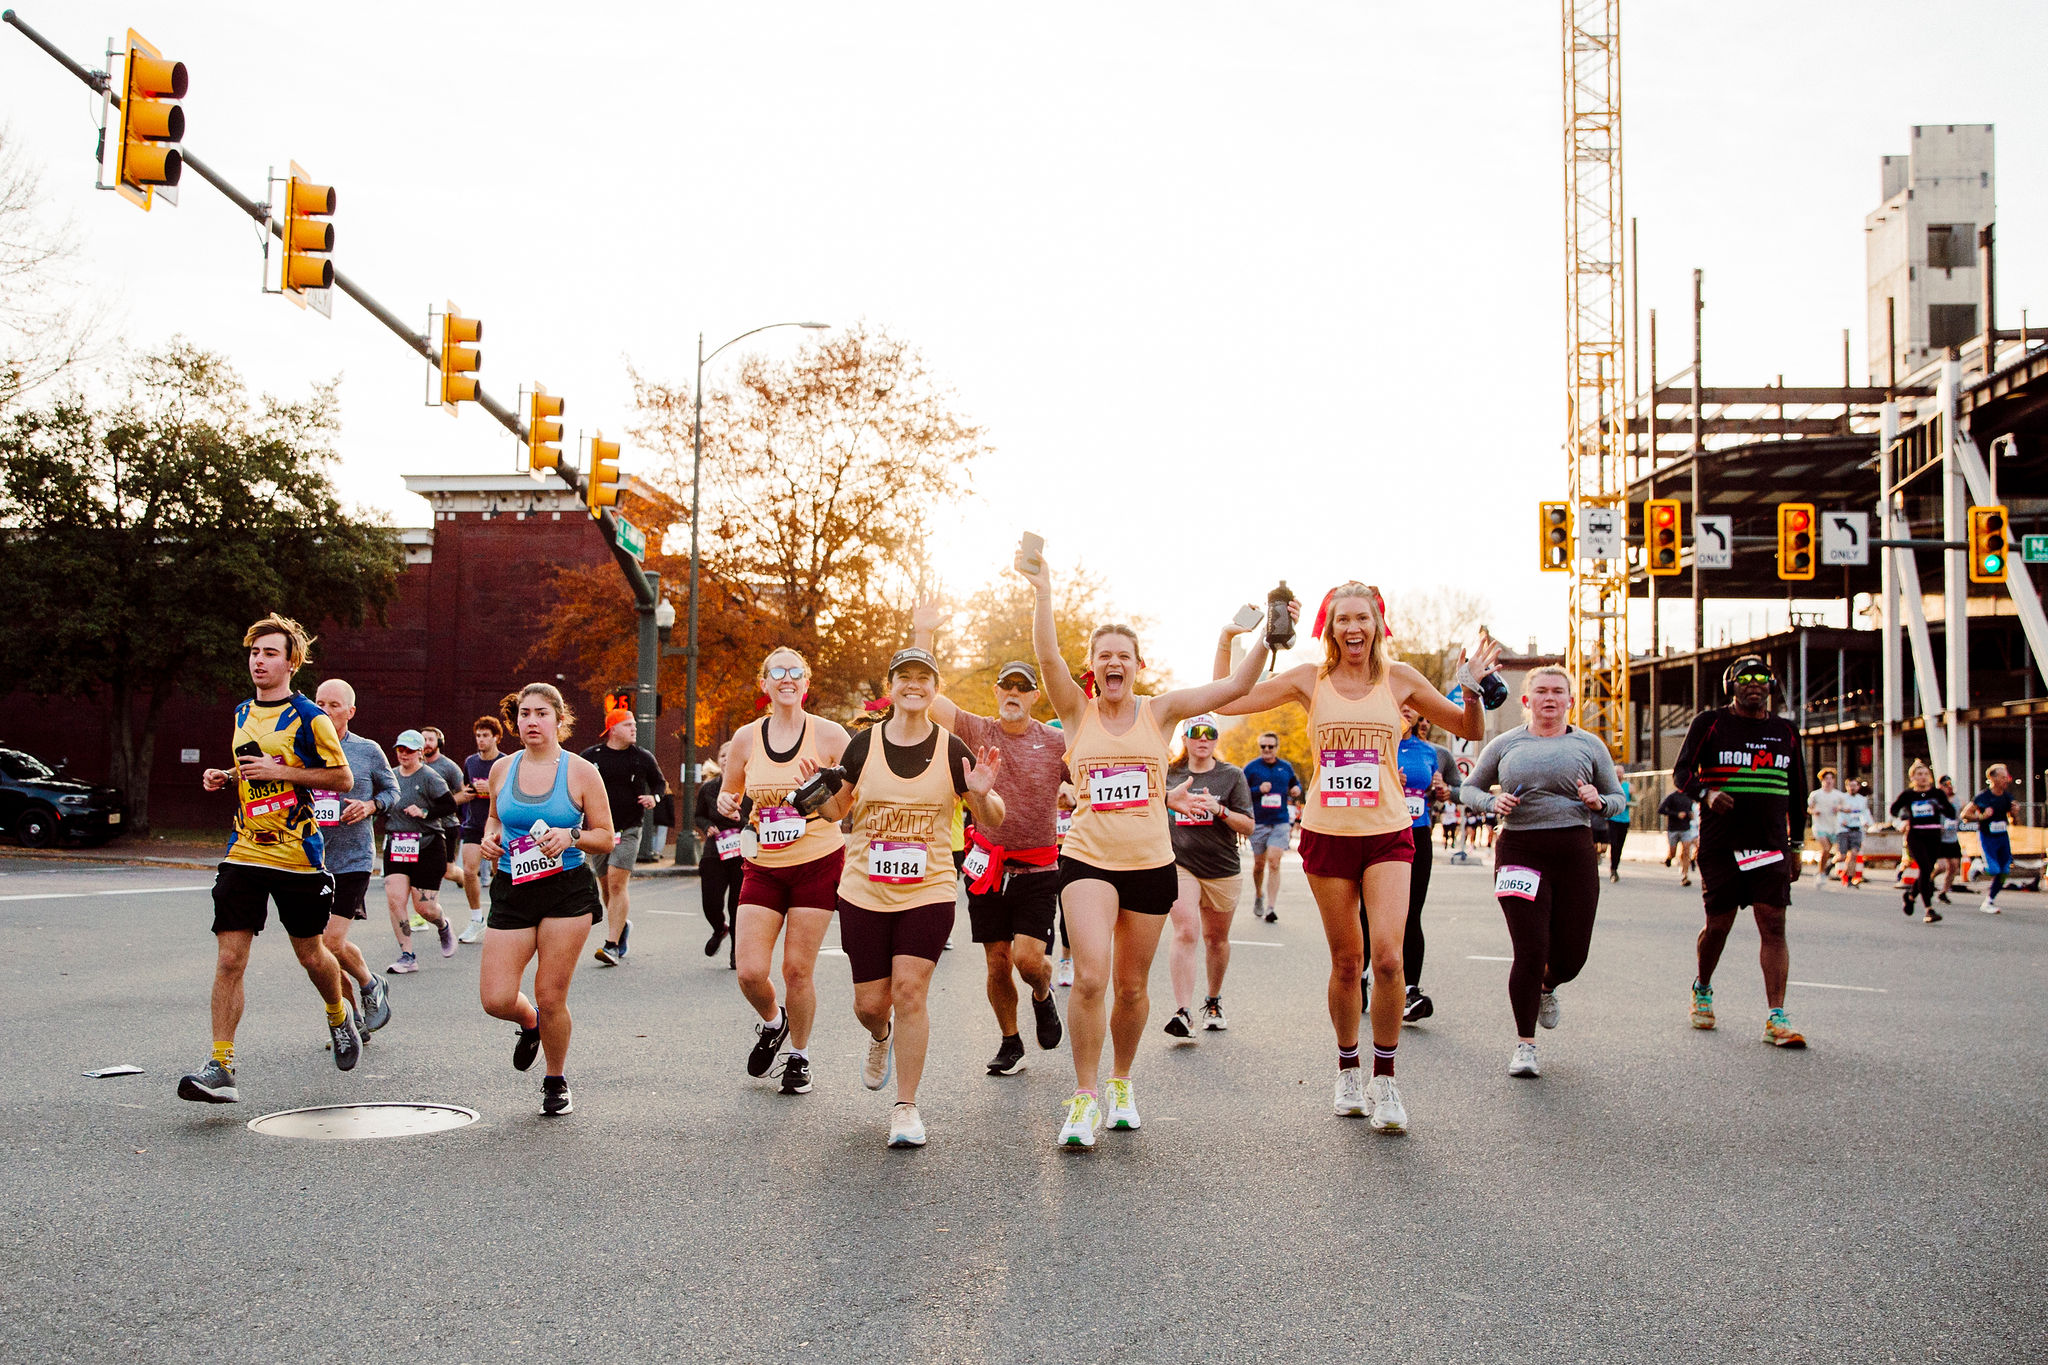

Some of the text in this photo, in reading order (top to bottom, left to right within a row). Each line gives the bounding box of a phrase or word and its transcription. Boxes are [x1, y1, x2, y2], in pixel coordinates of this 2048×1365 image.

[1588, 536, 1612, 545] ONLY
[1699, 554, 1727, 564] ONLY
[1831, 549, 1859, 560] ONLY
[1327, 776, 1372, 790] 15162
[247, 780, 285, 801] 30347
[1096, 784, 1141, 801] 17417
[764, 829, 800, 843] 17072
[394, 845, 416, 854] 20028
[515, 856, 557, 877] 20663
[874, 860, 920, 876] 18184
[1498, 879, 1532, 893] 20652
